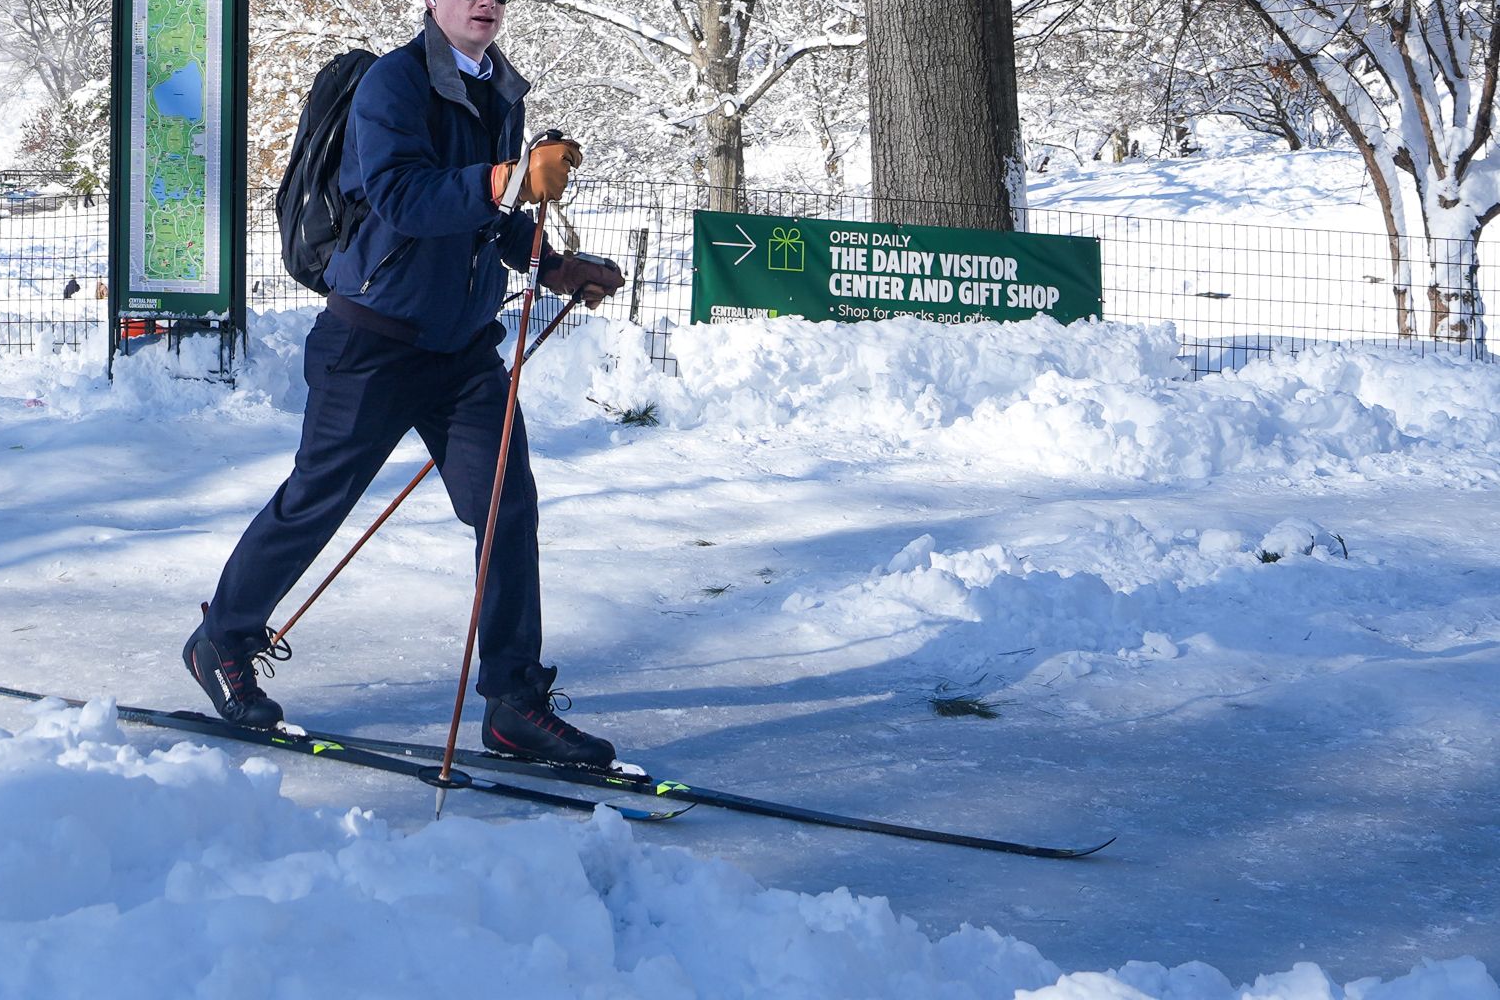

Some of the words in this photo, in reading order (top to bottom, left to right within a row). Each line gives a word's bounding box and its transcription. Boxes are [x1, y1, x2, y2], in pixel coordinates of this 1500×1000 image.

[829, 231, 868, 246] OPEN
[872, 233, 911, 248] DAILY
[829, 246, 868, 272] THE
[872, 249, 935, 276] DAIRY
[939, 253, 1018, 281] VISITOR
[829, 273, 905, 301] CENTER
[909, 277, 953, 303] AND
[958, 281, 1002, 307] GIFT
[1006, 284, 1060, 310] SHOP
[710, 305, 746, 318] CENTRAL
[747, 307, 768, 319] PARK
[838, 304, 870, 319] Shop
[873, 306, 890, 319] for
[941, 311, 960, 323] and
